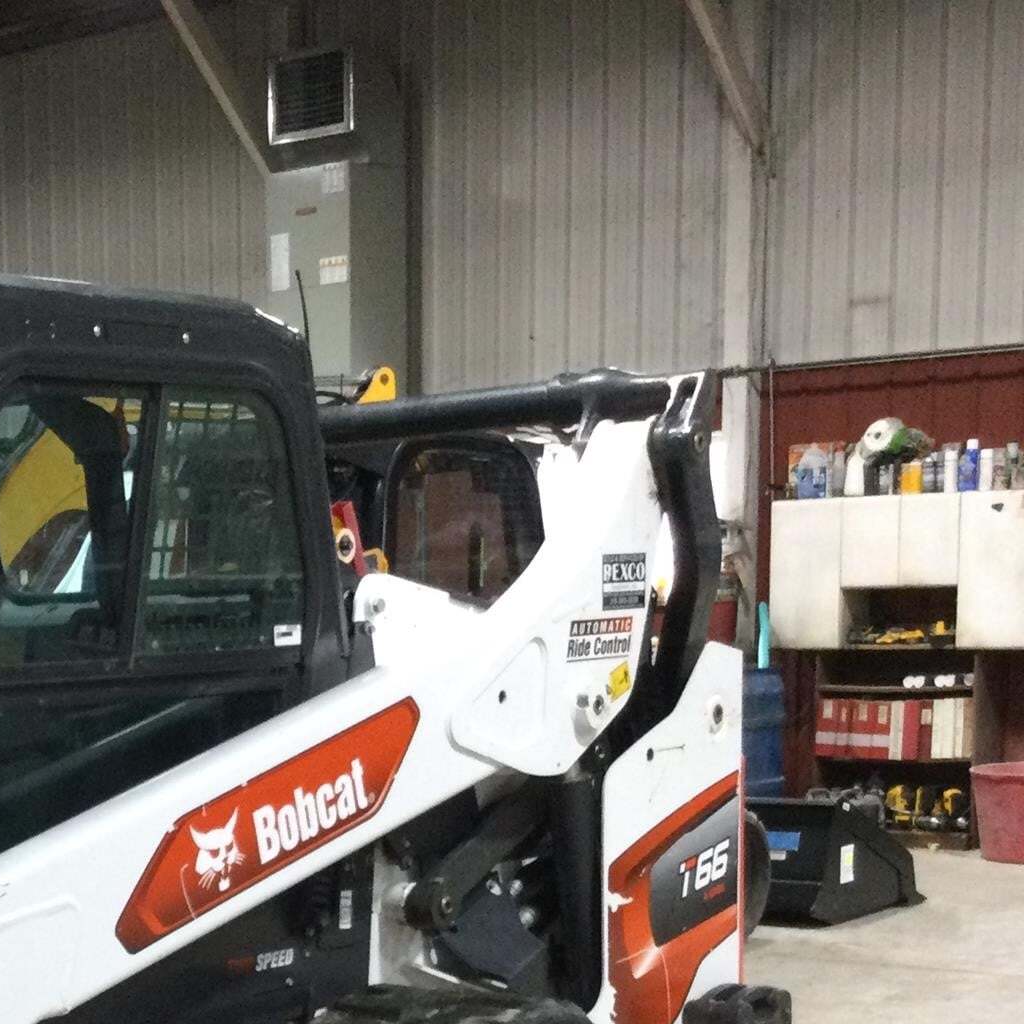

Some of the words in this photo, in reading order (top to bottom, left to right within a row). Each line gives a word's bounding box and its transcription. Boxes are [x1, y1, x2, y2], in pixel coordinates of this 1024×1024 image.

[570, 618, 632, 636] AUTOMATIC
[567, 638, 591, 658] Ride
[593, 635, 631, 655] Control
[252, 758, 367, 865] Bobcat
[679, 839, 730, 898] T66
[255, 948, 294, 972] SPEED
